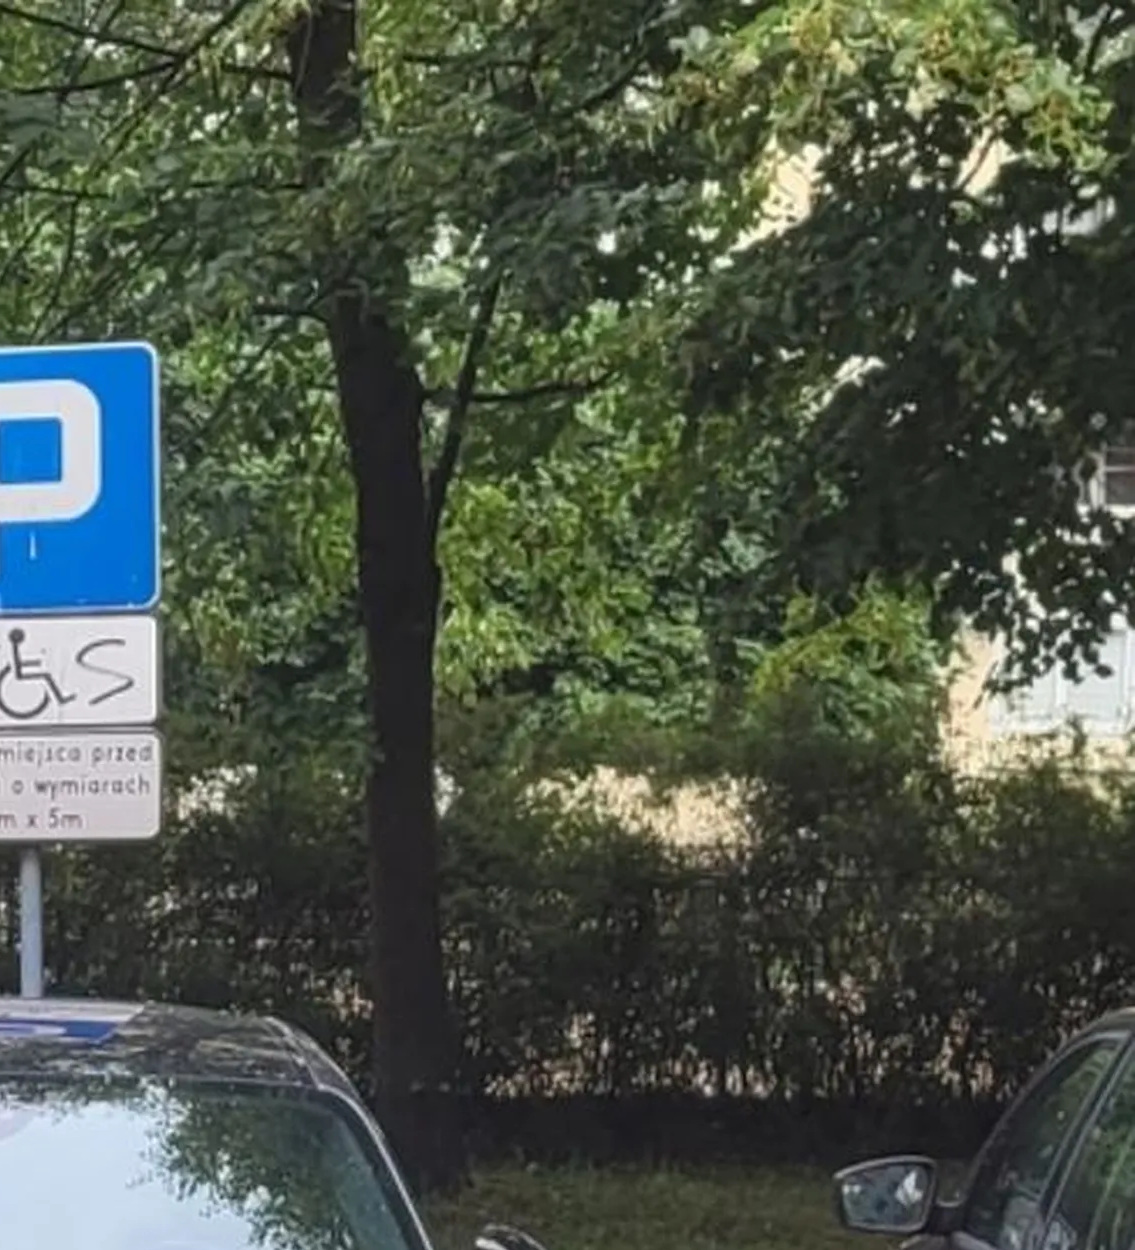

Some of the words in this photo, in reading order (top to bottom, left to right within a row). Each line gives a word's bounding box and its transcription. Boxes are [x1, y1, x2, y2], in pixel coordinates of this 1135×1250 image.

[76, 638, 134, 705] S
[91, 742, 154, 767] przed
[11, 781, 24, 796] o
[34, 774, 151, 800] wymiarach
[26, 813, 39, 829] x
[48, 807, 83, 829] 5m
